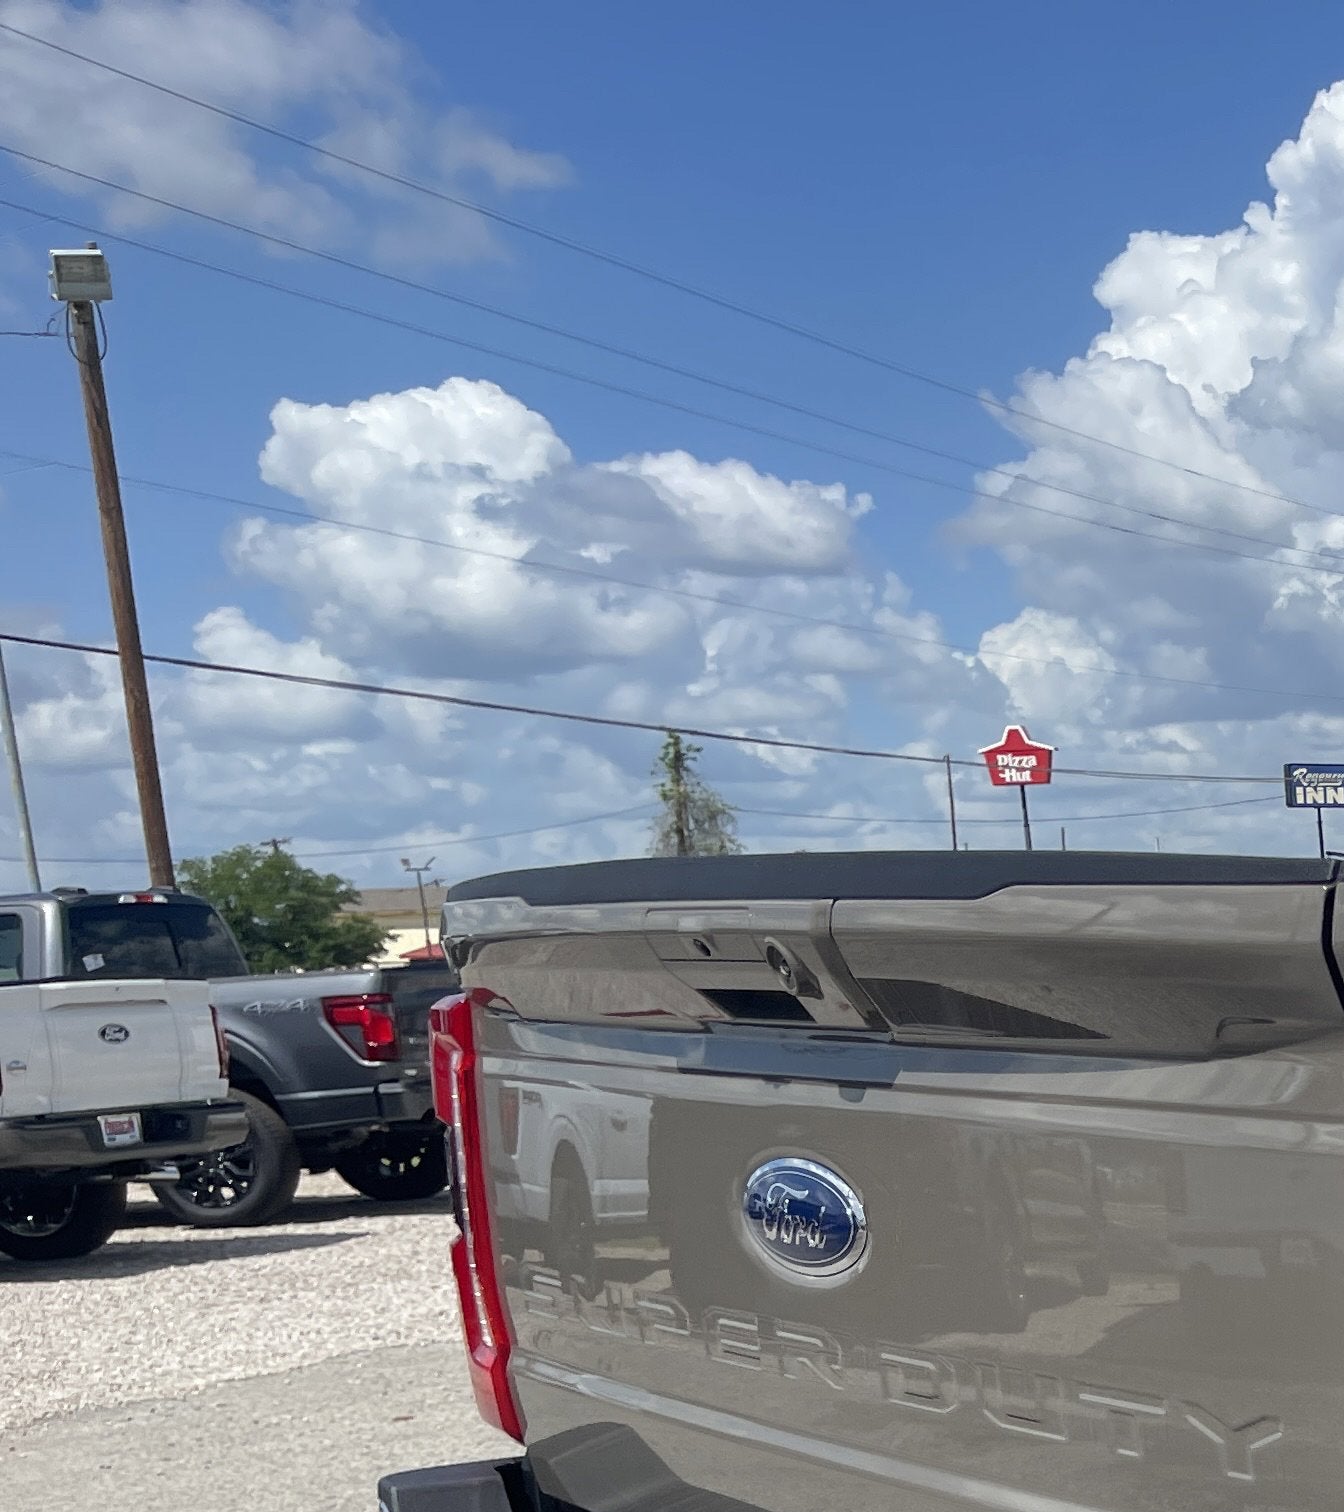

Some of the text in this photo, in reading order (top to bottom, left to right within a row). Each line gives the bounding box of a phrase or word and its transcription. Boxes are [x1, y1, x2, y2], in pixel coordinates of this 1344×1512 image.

[996, 753, 1038, 768] Pizza
[998, 767, 1033, 783] Hut
[524, 1261, 1284, 1481] SUPER DUTY
